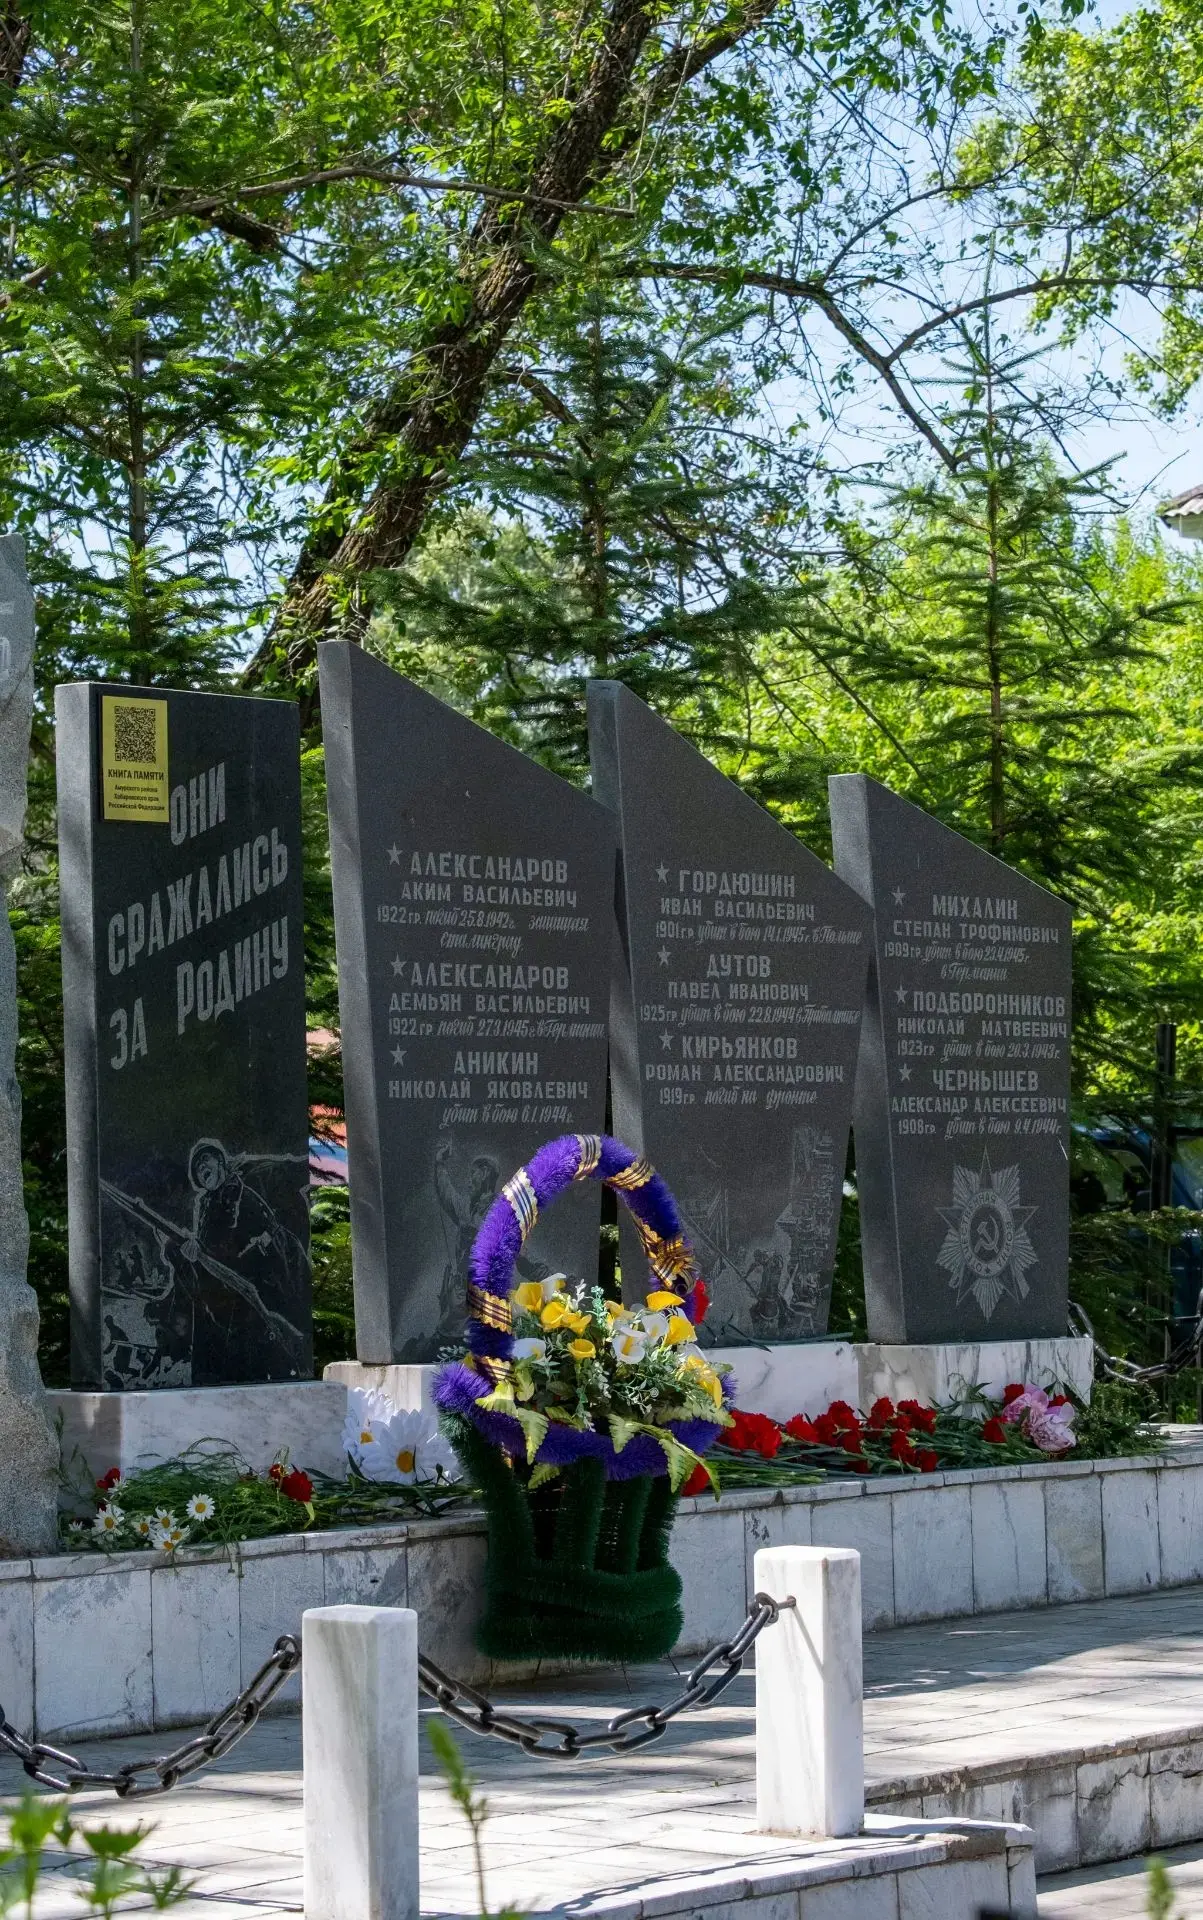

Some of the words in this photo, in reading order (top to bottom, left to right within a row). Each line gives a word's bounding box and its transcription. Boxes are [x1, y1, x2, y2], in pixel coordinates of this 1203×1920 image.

[108, 769, 133, 779] КНИГА
[134, 771, 164, 781] ПАМЯТИ
[108, 801, 137, 810] Российской
[138, 803, 165, 812] Федерации
[170, 762, 226, 846] ОНИ
[410, 851, 568, 884] АЛЕКСАНДРОВ
[401, 881, 450, 902] АКИМ
[463, 884, 577, 908] ВАСИЛЬЕВИЧ
[679, 870, 795, 898] ГОРДЮШИН
[107, 827, 288, 976] СРАЖАЛИСЬ
[660, 897, 702, 916] ИВАН
[714, 900, 815, 921] ВАСИЛЬЕВИЧ
[932, 894, 1018, 920] МИХАЛИН
[695, 920, 727, 945] убит
[729, 922, 738, 941] в
[738, 922, 761, 941] бою
[893, 919, 951, 938] СТЕПАН
[960, 923, 1059, 944] ТРОФИМОВИЧ
[955, 942, 962, 960] в
[962, 943, 983, 961] бою
[411, 962, 570, 991] АЛЕКСАНДРОВ
[706, 953, 771, 978] ДУТОВ
[109, 997, 148, 1071] ЗА
[176, 915, 289, 1036] РОДИНУ
[668, 981, 720, 999] ПАВЕЛ
[729, 983, 809, 1002] ИВАНОВИЧ
[913, 990, 1065, 1017] ПОДБОРОННИКОВ
[389, 993, 462, 1013] ДЕМЬЯН
[475, 994, 590, 1015] ВАСИЛЬЕВИЧ
[678, 1003, 712, 1027] убит
[714, 1003, 722, 1022] в
[723, 1003, 746, 1023] бою
[897, 1015, 965, 1035] НИКОЛАЙ
[981, 1020, 1067, 1038] МАТВЕЕВИЧ
[682, 1035, 799, 1059] КИРЬЯНКОВ
[939, 1039, 972, 1063] убит
[975, 1039, 983, 1057] в
[984, 1040, 1006, 1058] бою
[453, 1051, 539, 1075] АНИКИН
[645, 1064, 701, 1081] РОМАН
[713, 1064, 844, 1084] АЛЕКСАНДРОВИЧ
[388, 1077, 471, 1099] НИКОЛАЙ
[487, 1081, 588, 1100] ЯКОВЛЕВИЧ
[932, 1069, 1039, 1092] ЧЕРНЫШЕВ
[704, 1085, 741, 1105] погиб
[741, 1089, 757, 1105] на
[891, 1096, 968, 1116] АЛЕКСАНДР
[973, 1097, 1067, 1113] АЛЕКСЕЕВИЧ
[438, 1103, 479, 1130] убит
[481, 1103, 491, 1123] в
[492, 1103, 518, 1123] бою
[944, 1116, 976, 1141] убит
[979, 1116, 987, 1135] в
[987, 1117, 1010, 1135] бою
